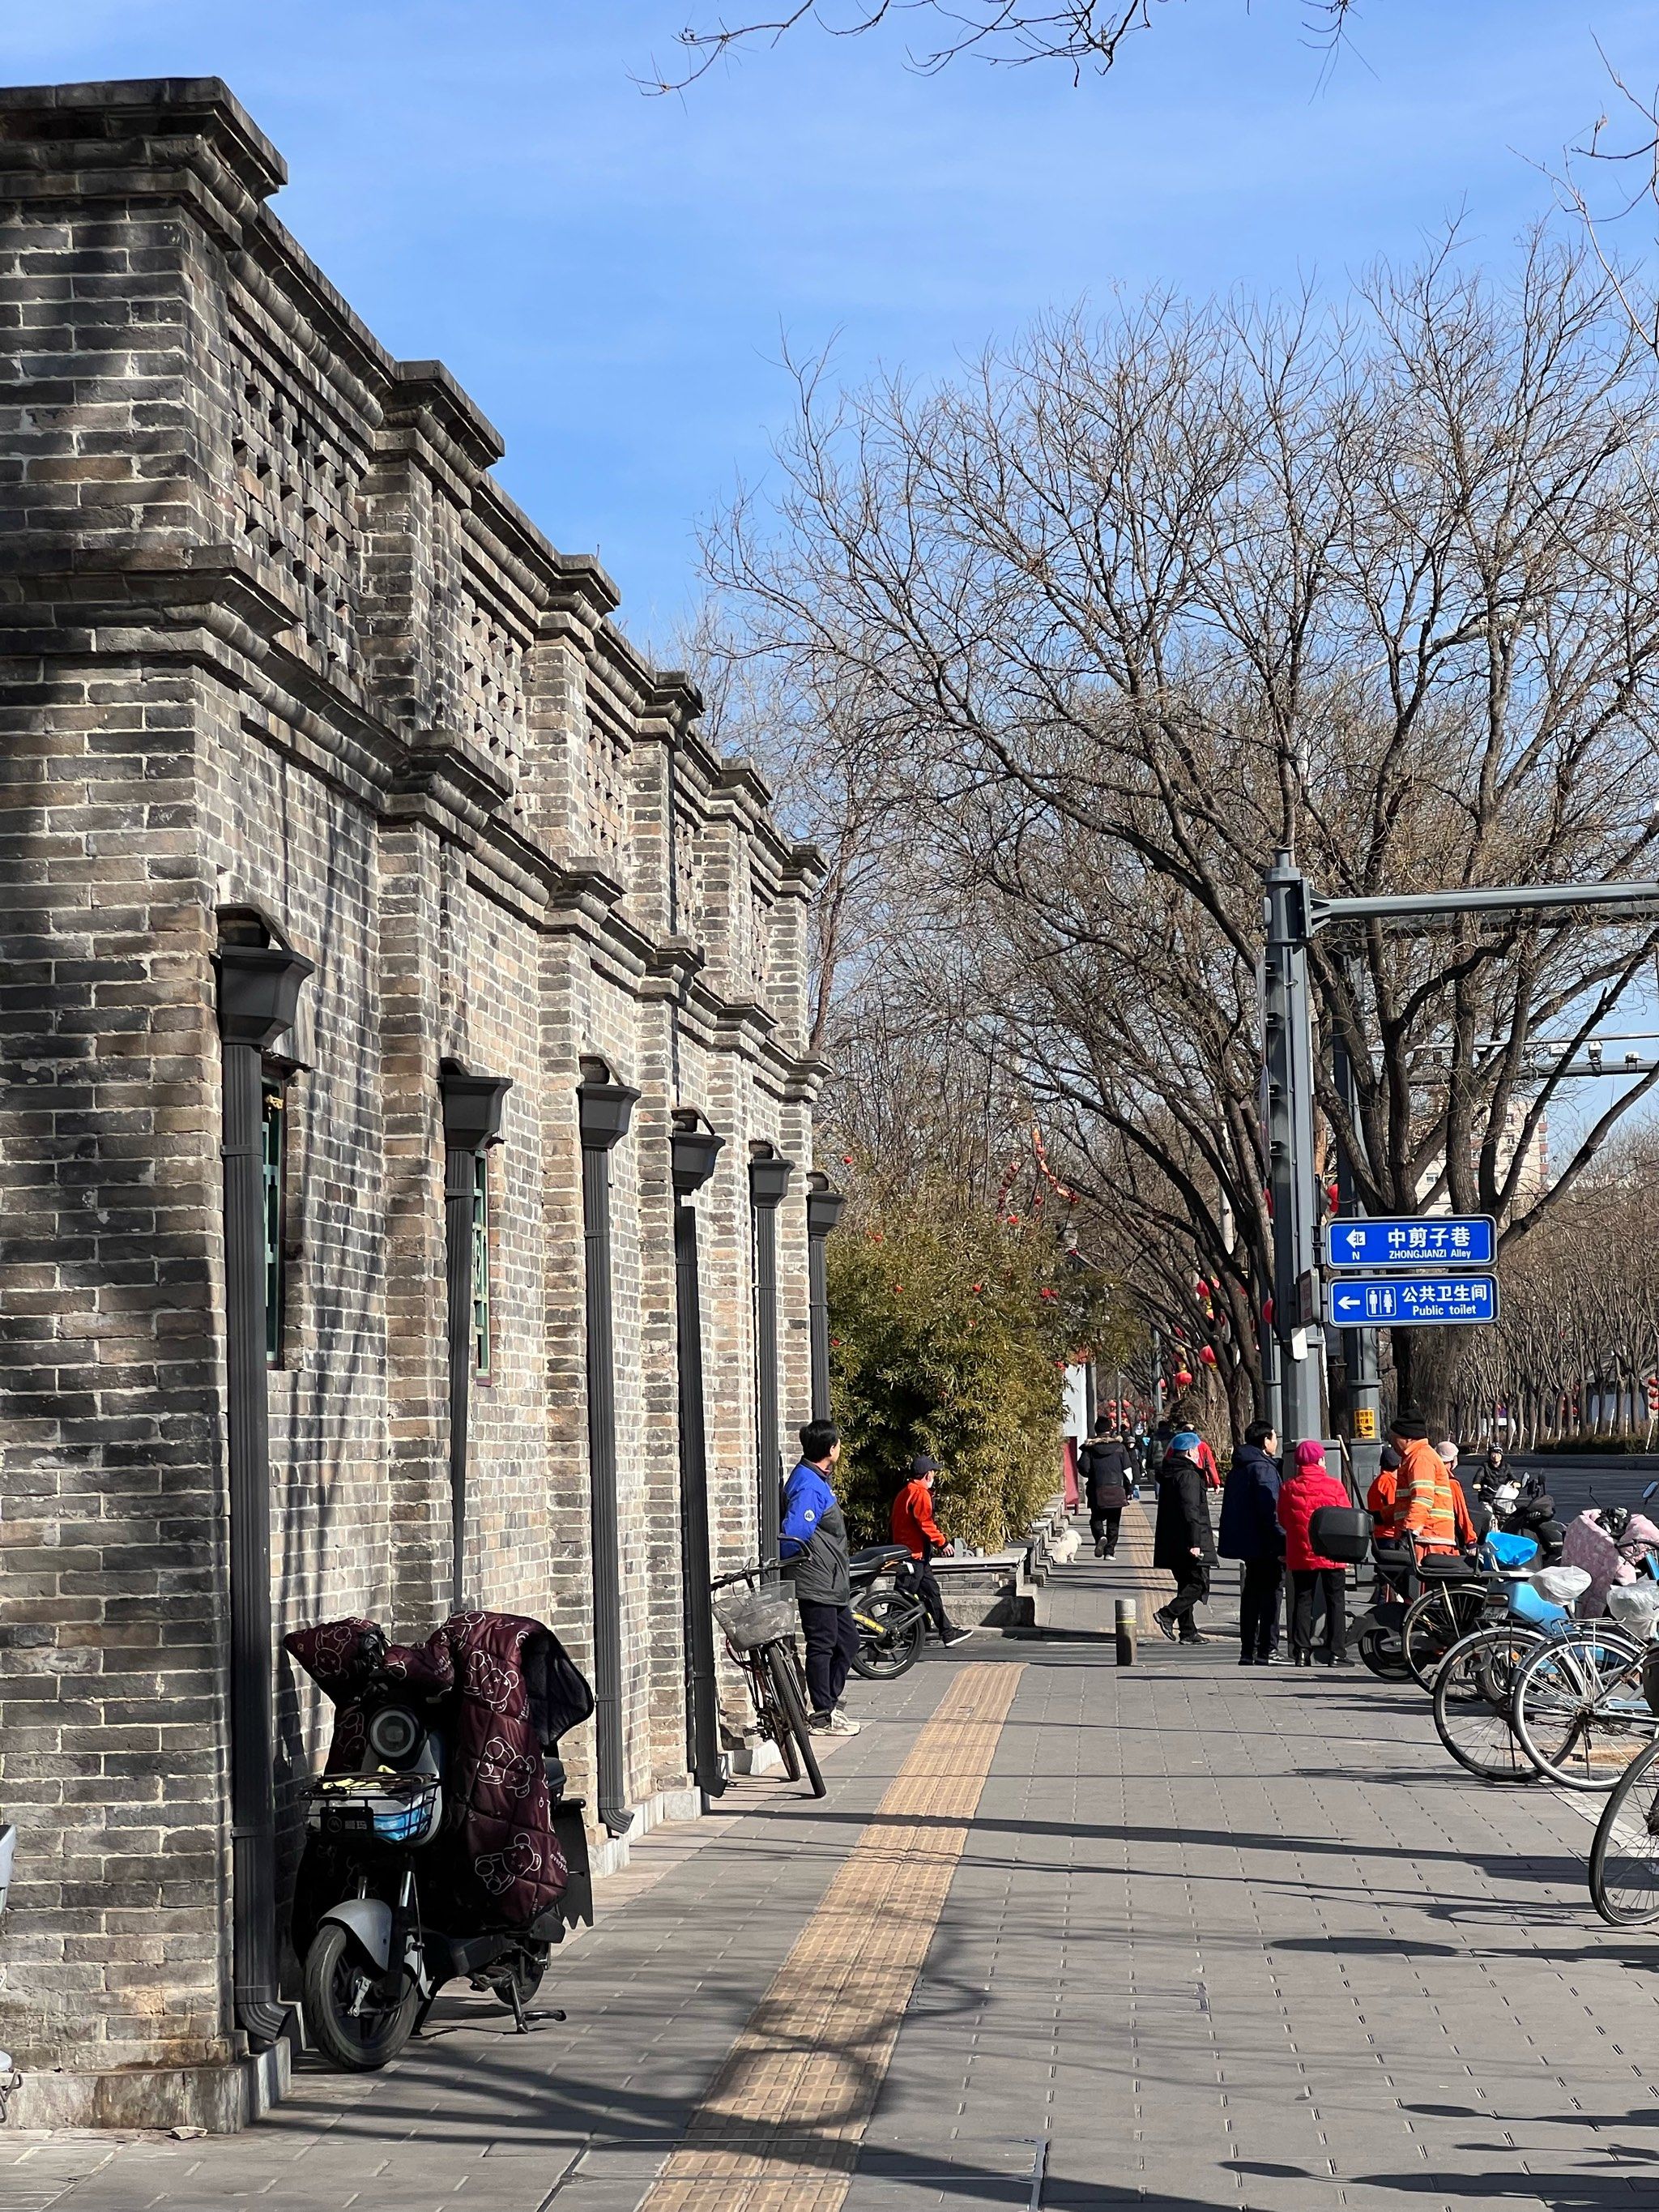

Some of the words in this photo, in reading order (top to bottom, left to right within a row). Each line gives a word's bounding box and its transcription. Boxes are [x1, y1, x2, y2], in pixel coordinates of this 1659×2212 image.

[1388, 1227, 1471, 1249] 中剪子巷
[1352, 1252, 1360, 1260] N
[1388, 1249, 1447, 1259] ZHONGJIANZI
[1450, 1249, 1471, 1259] Alley
[1401, 1284, 1487, 1304] 公共卫生间
[1413, 1305, 1444, 1317] Public
[1449, 1304, 1477, 1315] toilet
